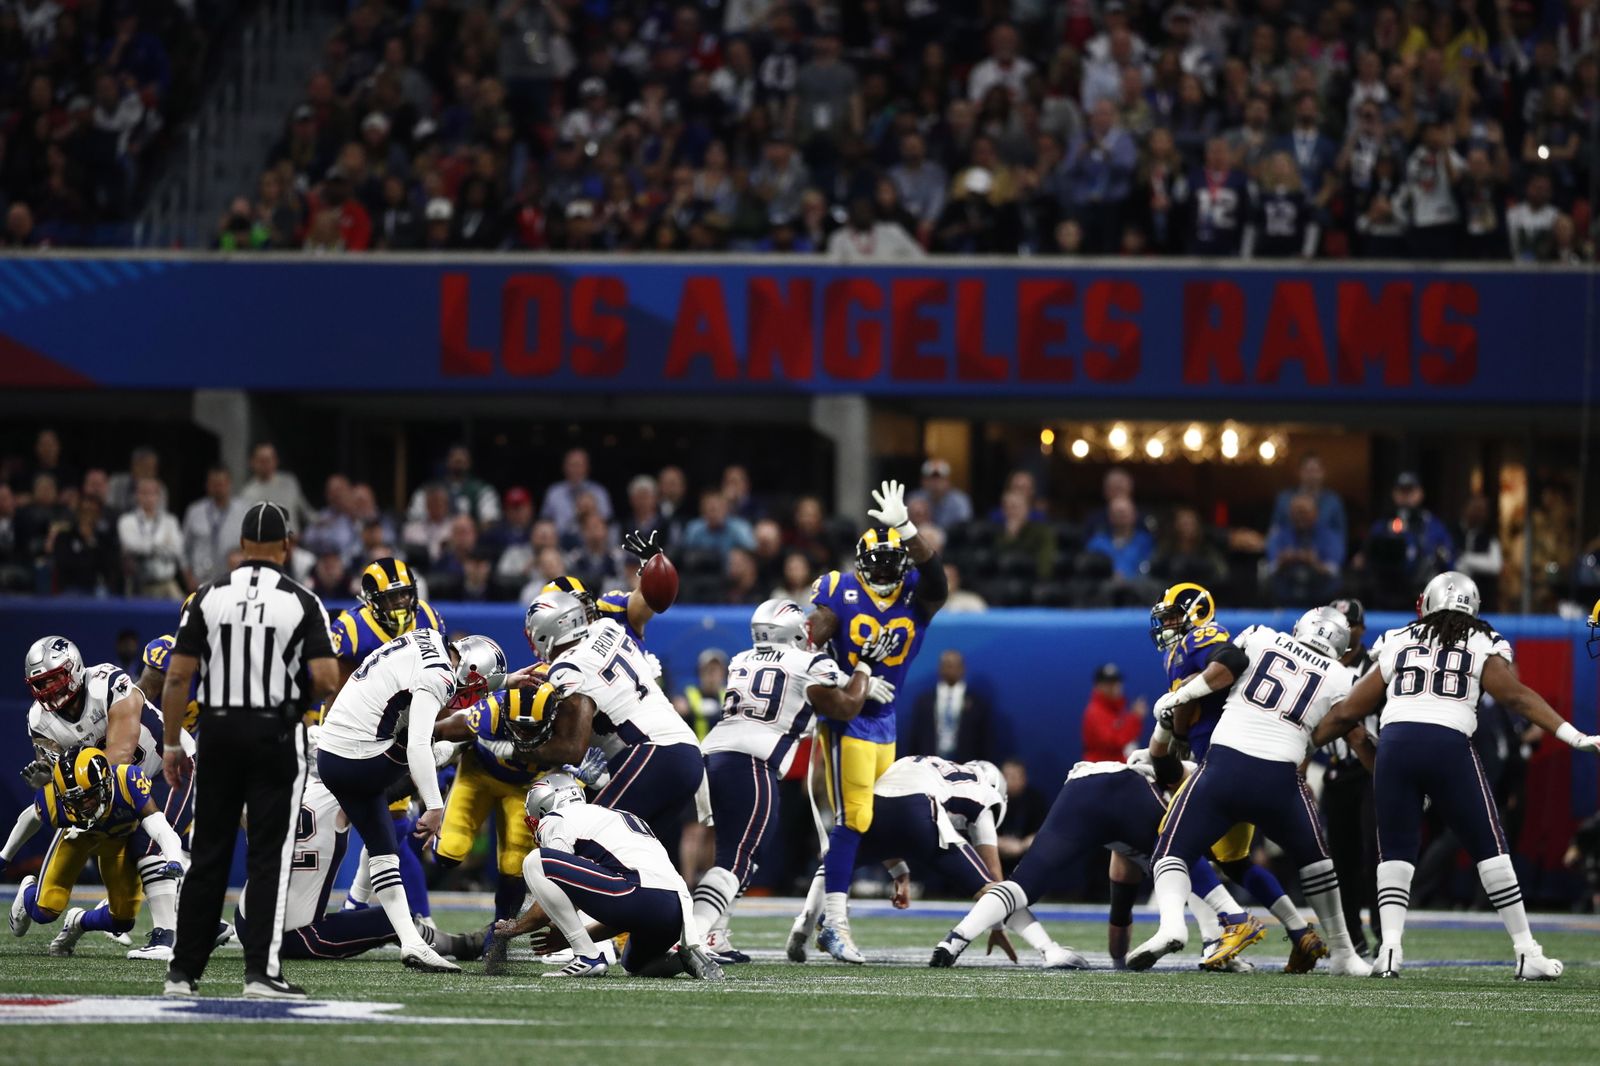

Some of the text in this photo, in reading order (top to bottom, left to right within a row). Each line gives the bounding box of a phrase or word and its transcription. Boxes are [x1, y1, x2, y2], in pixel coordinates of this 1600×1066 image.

[440, 273, 1479, 386] LOS ANGELES RAMS
[149, 645, 169, 666] 41
[591, 624, 621, 658] BROWN
[1275, 635, 1332, 672] CANNON
[1317, 626, 1333, 640] 61
[724, 665, 789, 724] 69
[1242, 648, 1326, 731] 61
[1393, 644, 1474, 702] 68
